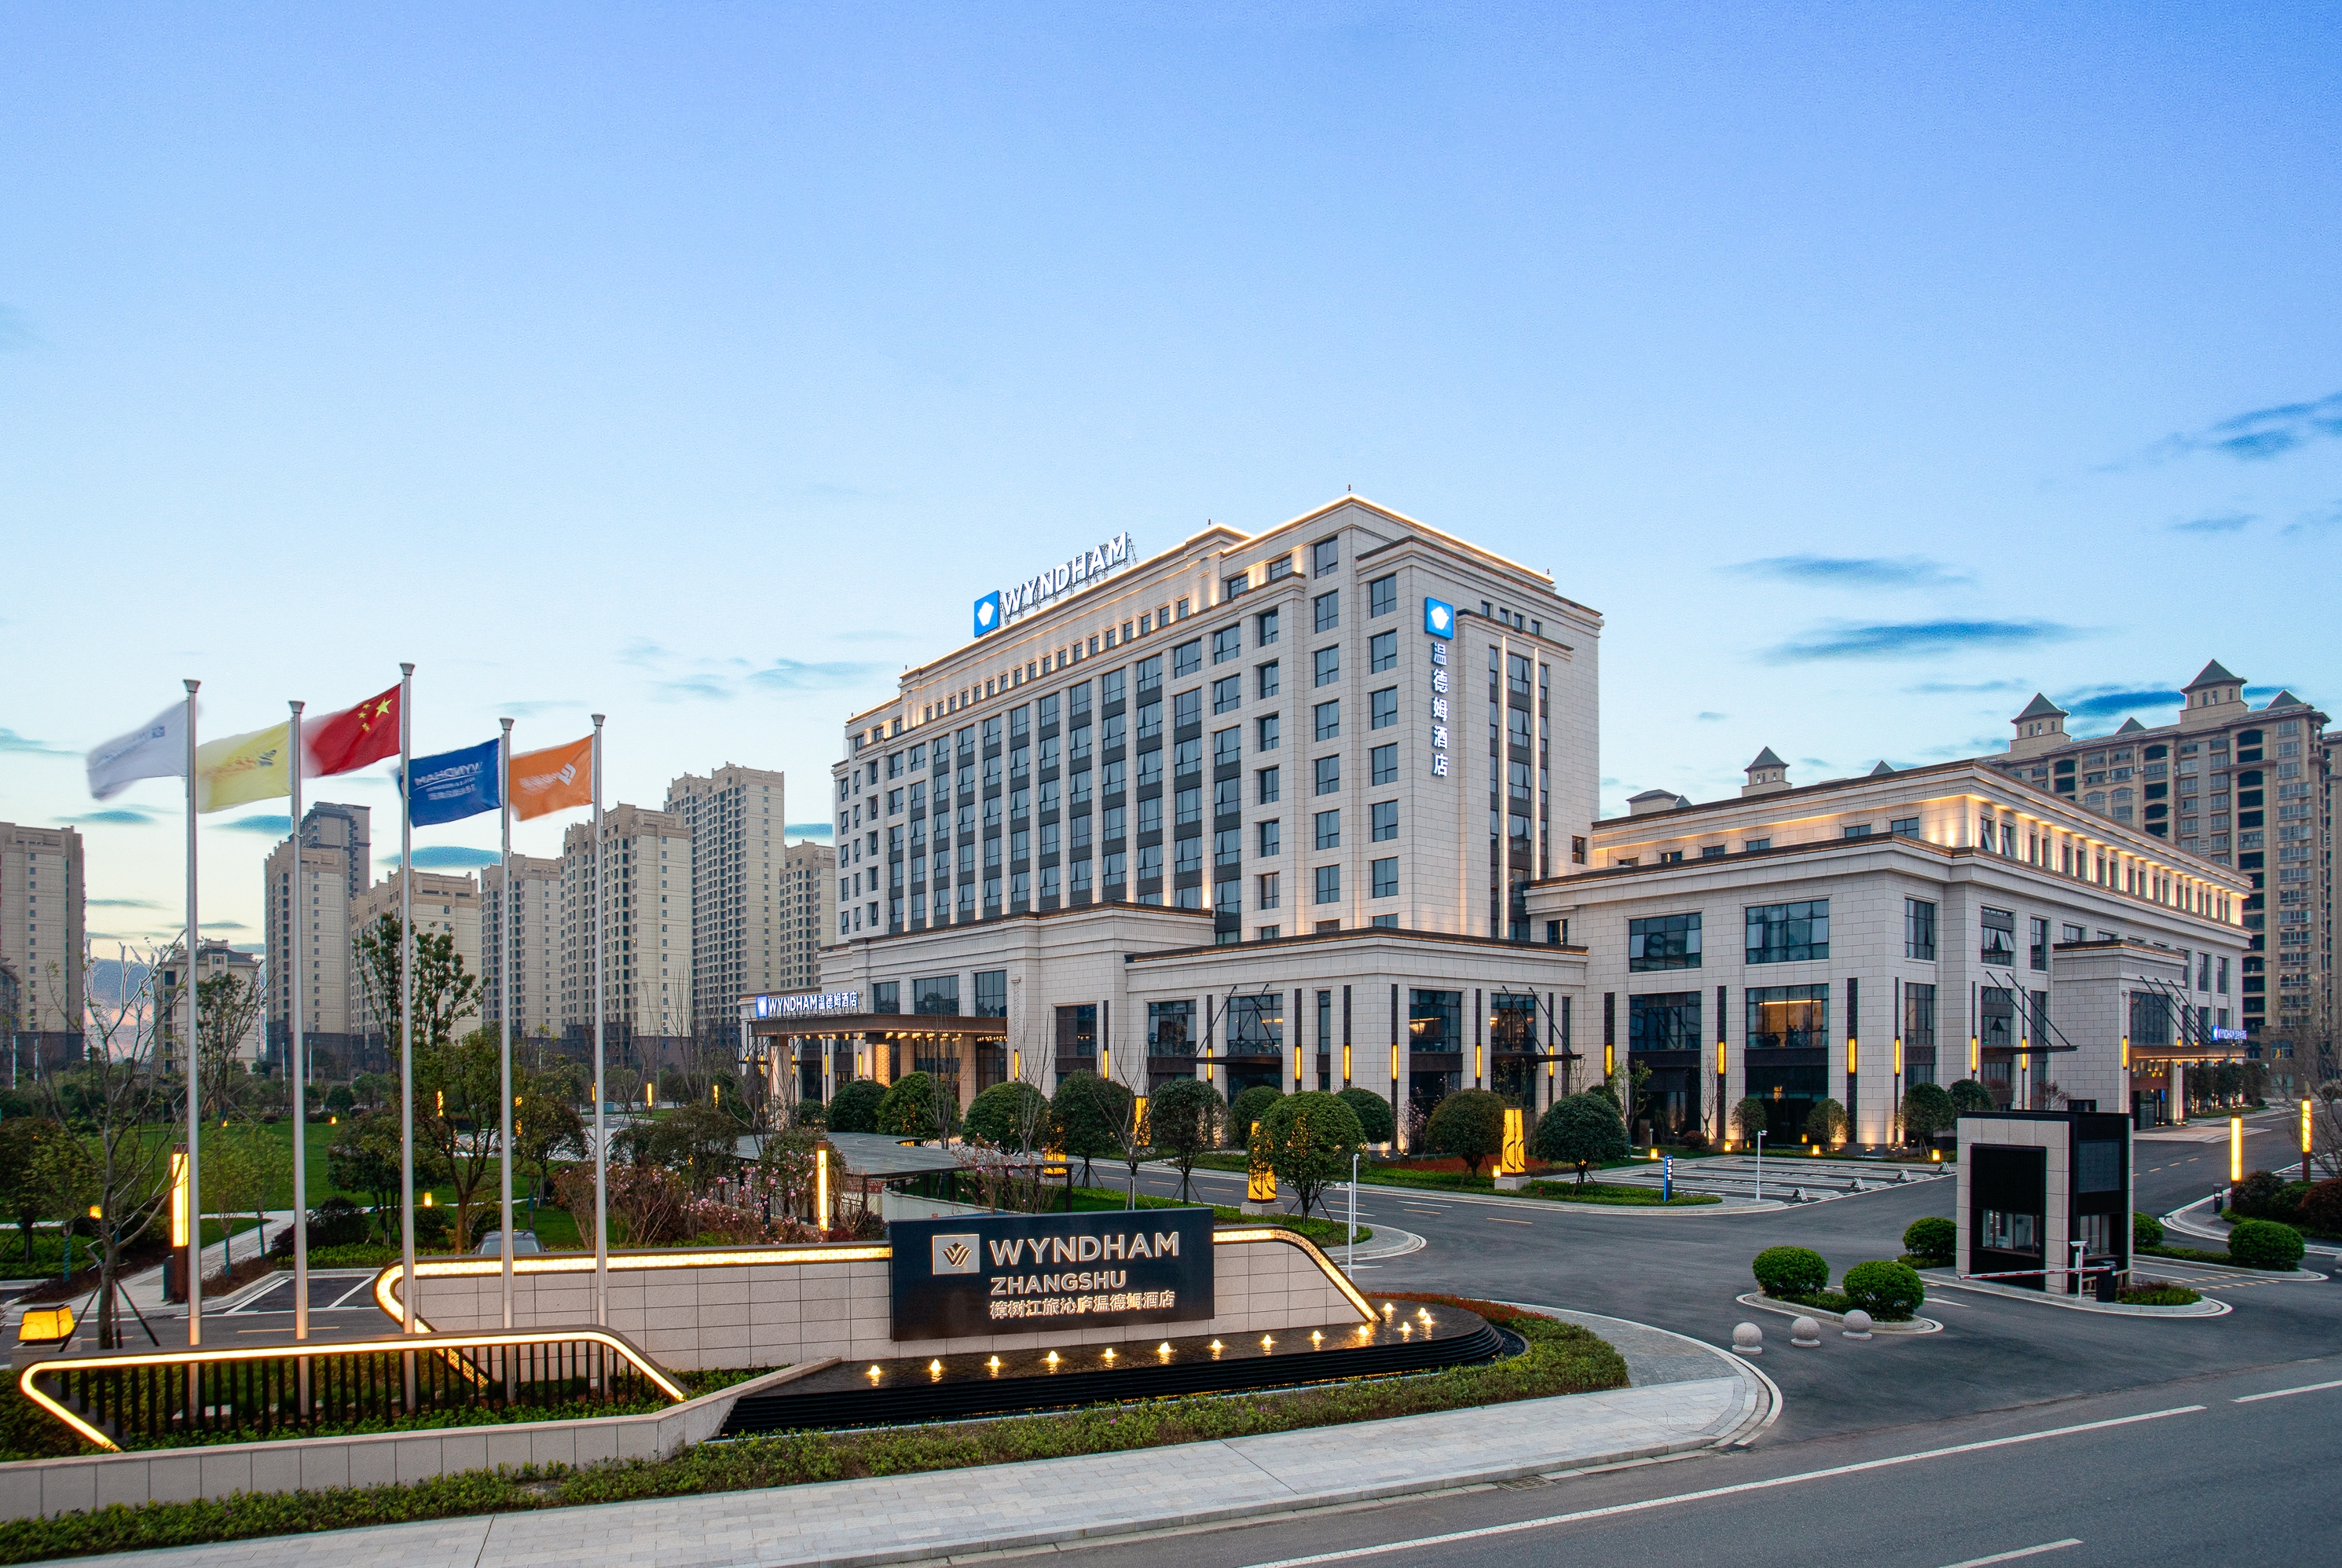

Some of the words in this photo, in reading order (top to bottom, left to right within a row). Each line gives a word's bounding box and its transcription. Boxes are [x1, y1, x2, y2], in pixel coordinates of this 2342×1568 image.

[1002, 532, 1127, 617] WYNDHAM
[1431, 641, 1449, 778] 温德姆酒店
[768, 995, 818, 1013] WYNDHAM
[819, 991, 857, 1009] 温德姆酒店
[989, 1232, 1179, 1266] WYNDHAM
[991, 1270, 1127, 1296] ZHANGSHU
[990, 1290, 1175, 1319] 樟树江旅沁庐温德姆酒店
